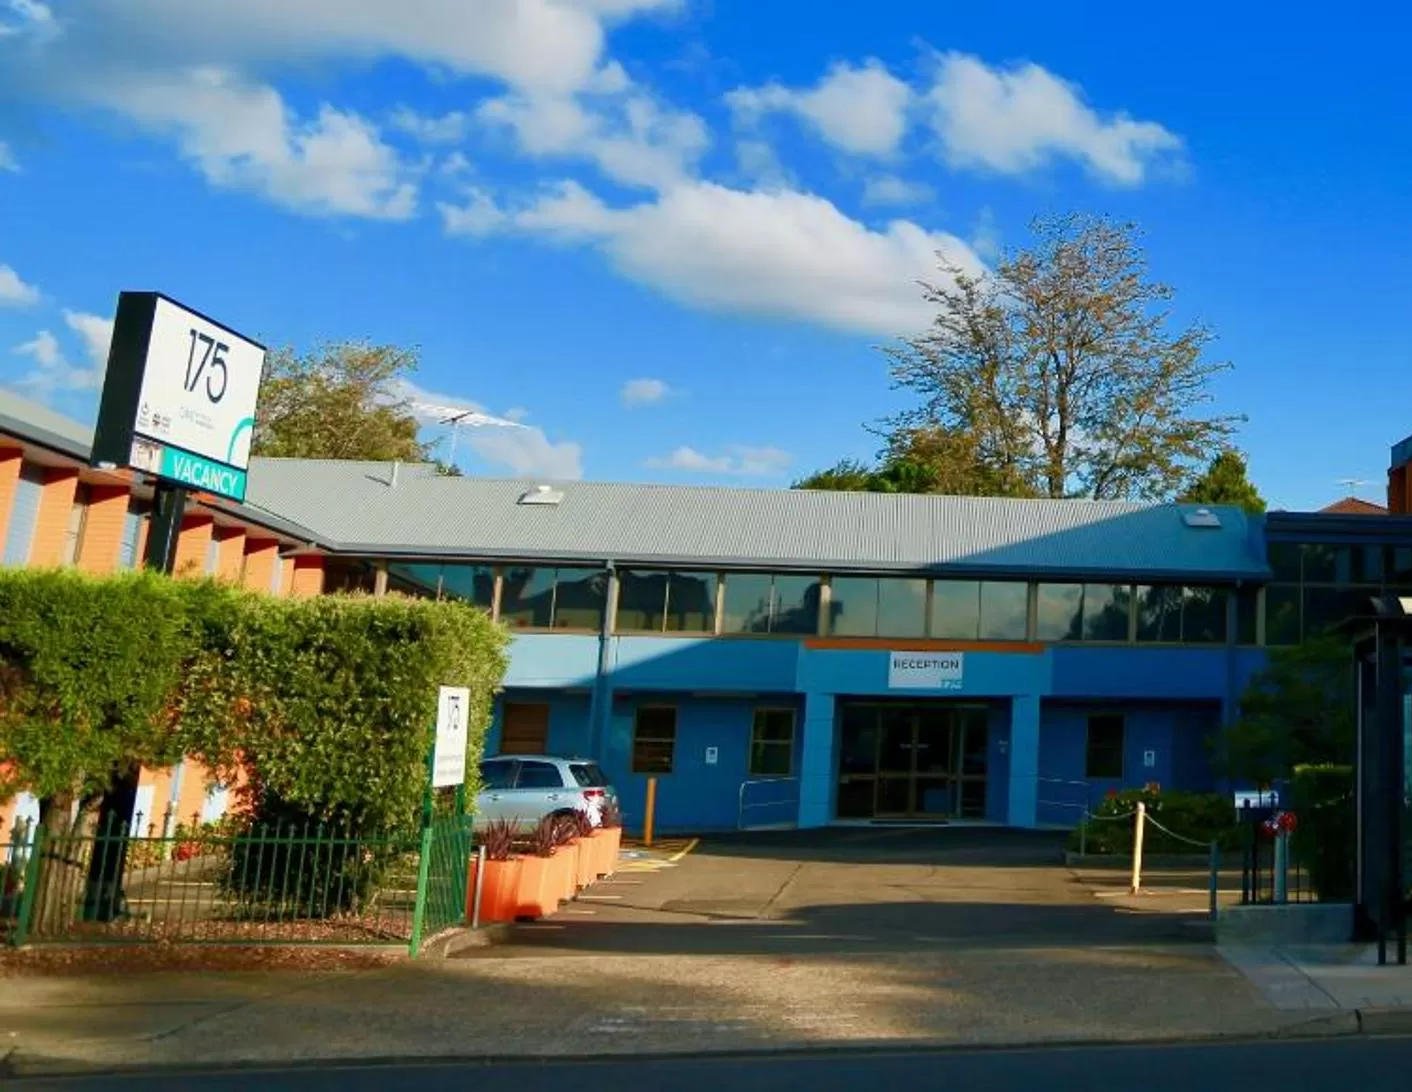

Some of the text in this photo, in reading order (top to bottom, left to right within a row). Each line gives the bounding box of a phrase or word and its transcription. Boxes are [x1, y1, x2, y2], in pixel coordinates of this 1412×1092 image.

[184, 328, 231, 405] 175
[173, 454, 239, 495] VACANCY
[893, 659, 960, 669] RECEPTION
